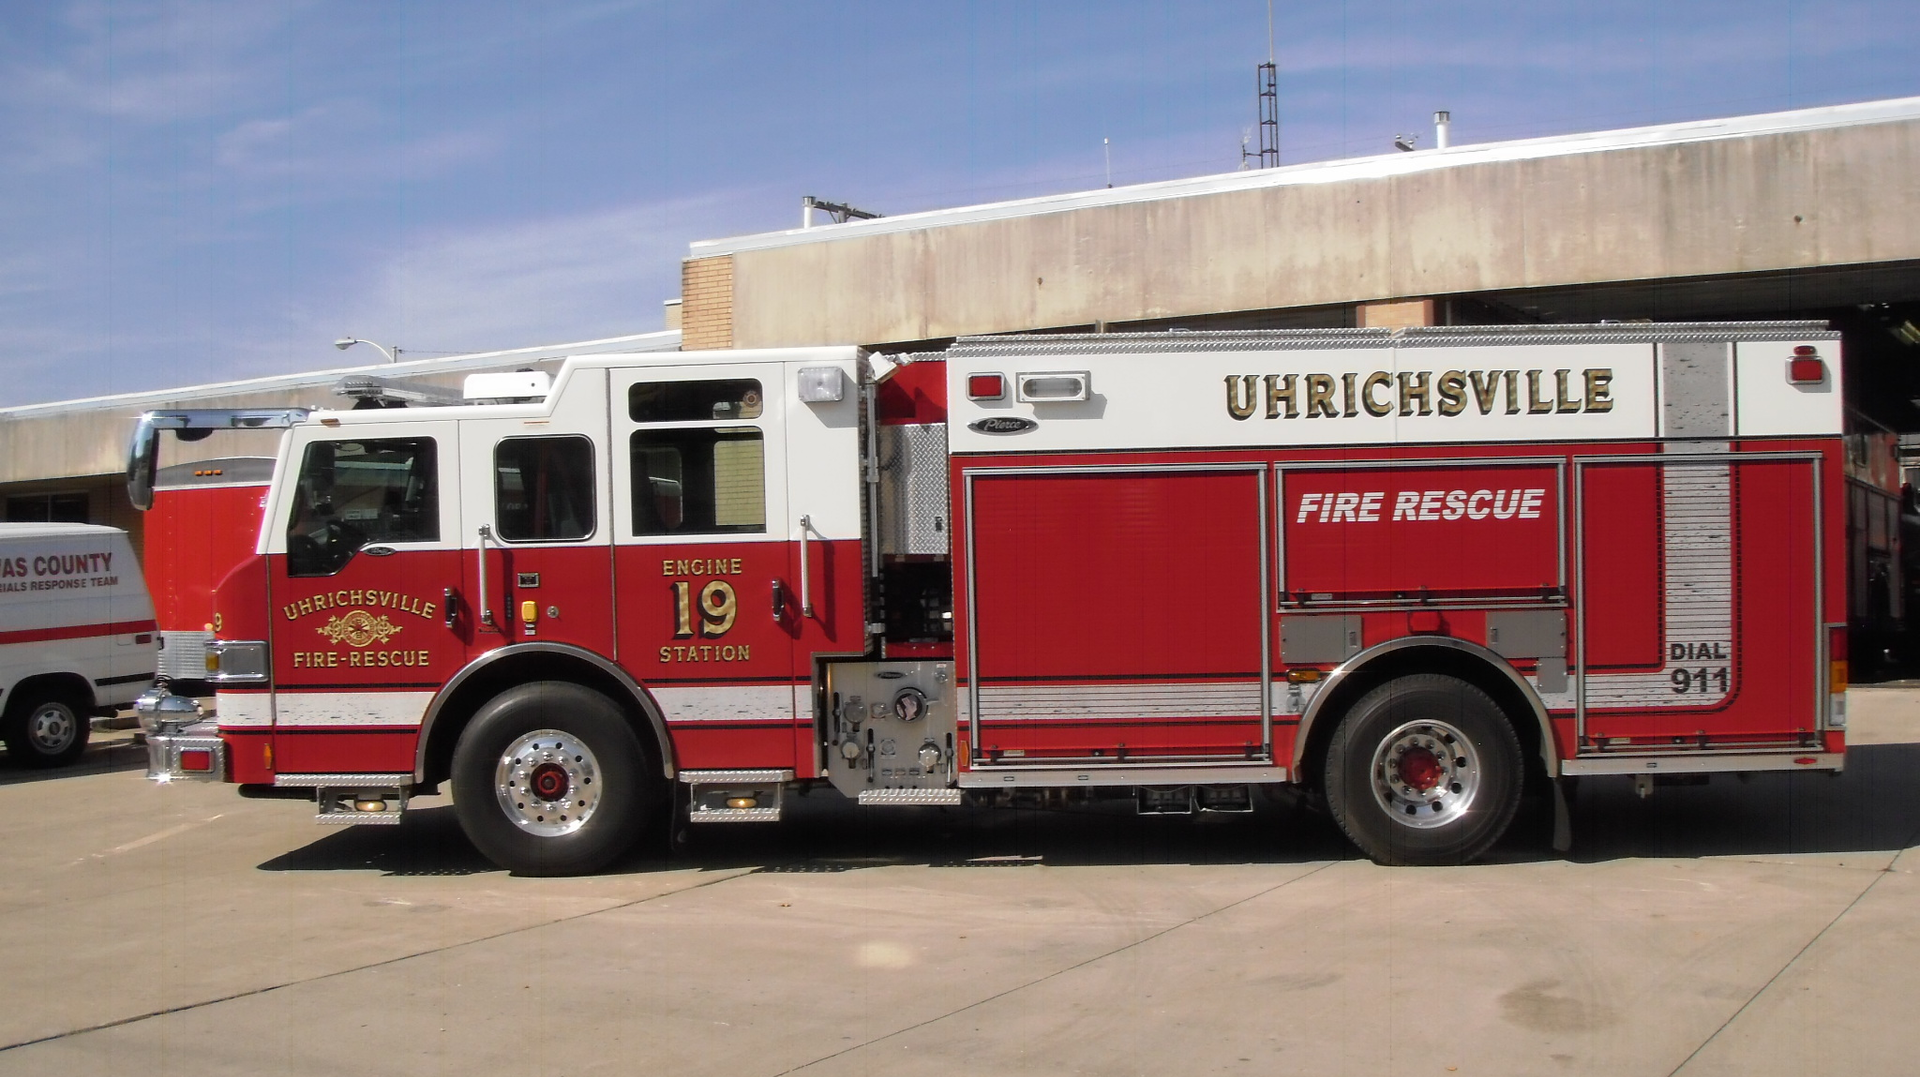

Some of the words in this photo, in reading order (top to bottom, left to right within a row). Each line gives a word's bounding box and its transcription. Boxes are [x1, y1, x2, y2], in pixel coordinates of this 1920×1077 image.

[1224, 368, 1614, 421] UHRICHSVILLE
[983, 419, 1021, 431] Pierce
[1296, 491, 1385, 523] FIRE
[1392, 489, 1546, 521] RESCUE
[0, 557, 28, 578] AS
[34, 552, 112, 576] COUNTY
[662, 558, 742, 576] ENGINE
[30, 578, 87, 591] RESPONSE
[90, 576, 119, 587] TEAM
[283, 589, 437, 621] UHRICHSVILLE
[669, 579, 738, 640] 19
[293, 650, 430, 668] FIRE-RESCUE
[659, 645, 750, 663] STATION
[1670, 643, 1727, 660] DIAL
[1671, 667, 1727, 694] 911
